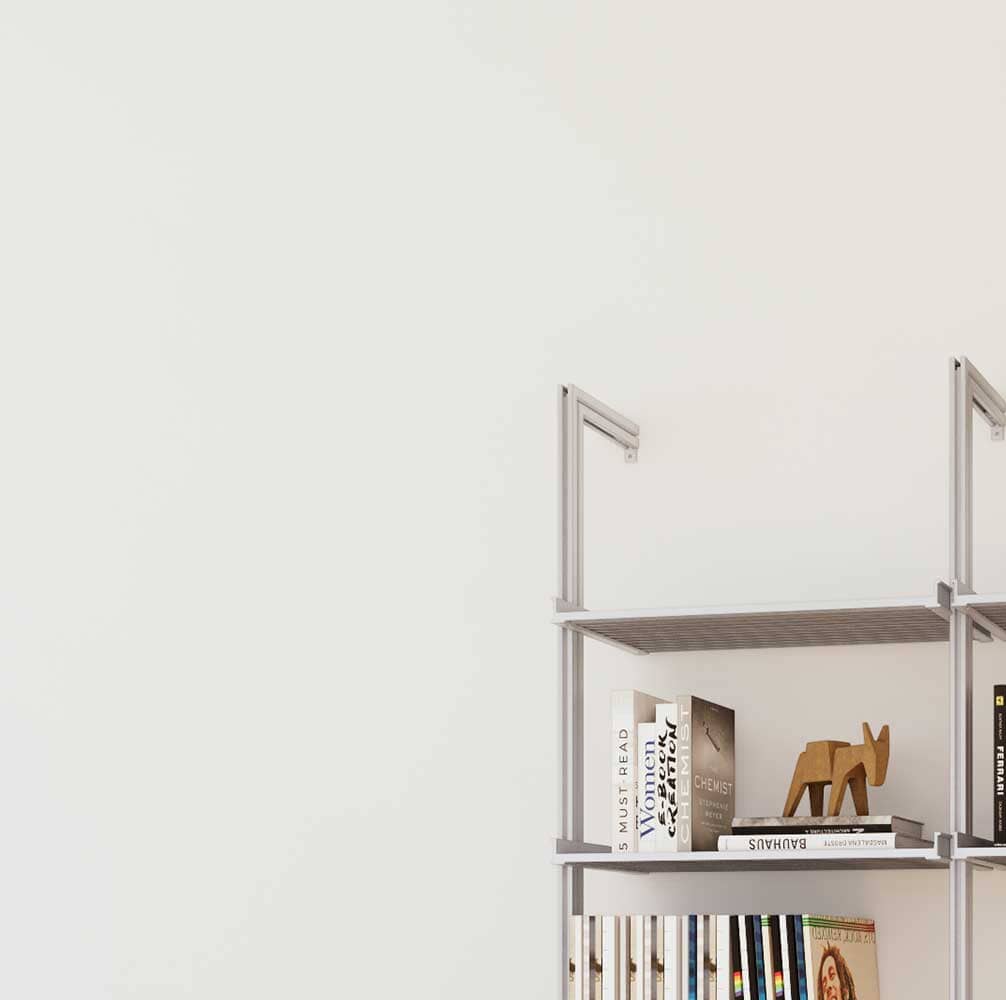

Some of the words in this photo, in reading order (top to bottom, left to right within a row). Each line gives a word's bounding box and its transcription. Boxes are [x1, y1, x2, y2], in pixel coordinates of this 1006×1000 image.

[639, 740, 656, 838] Women
[657, 728, 667, 826] E-BOOK
[666, 716, 678, 838] CREATION
[680, 704, 690, 844] CHEMIST
[694, 775, 733, 796] CHEMIST
[996, 746, 1004, 796] FERRARI
[618, 842, 628, 851] 5
[749, 838, 807, 851] BAUHAUS
